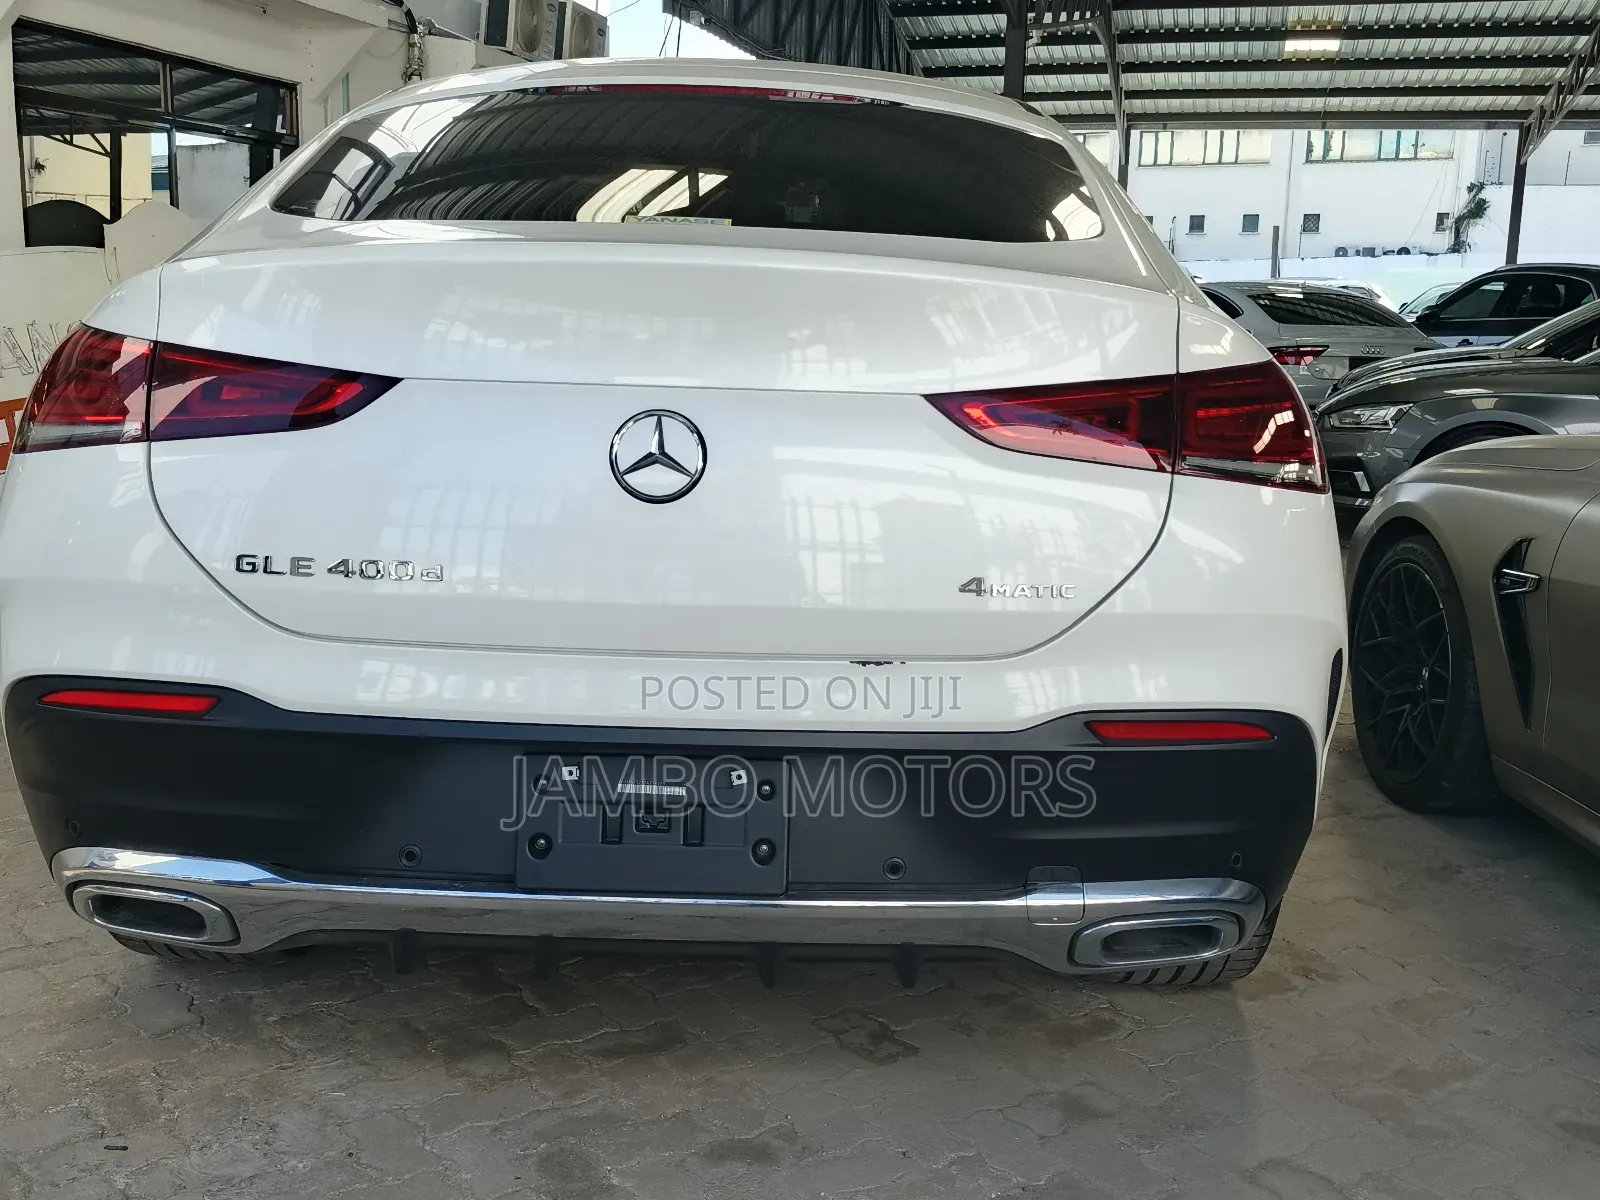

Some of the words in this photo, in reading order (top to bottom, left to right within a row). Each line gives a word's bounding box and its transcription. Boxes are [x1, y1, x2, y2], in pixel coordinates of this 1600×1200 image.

[634, 216, 725, 225] YANASE
[234, 553, 316, 577] GLE
[958, 576, 1076, 600] 4MATIC
